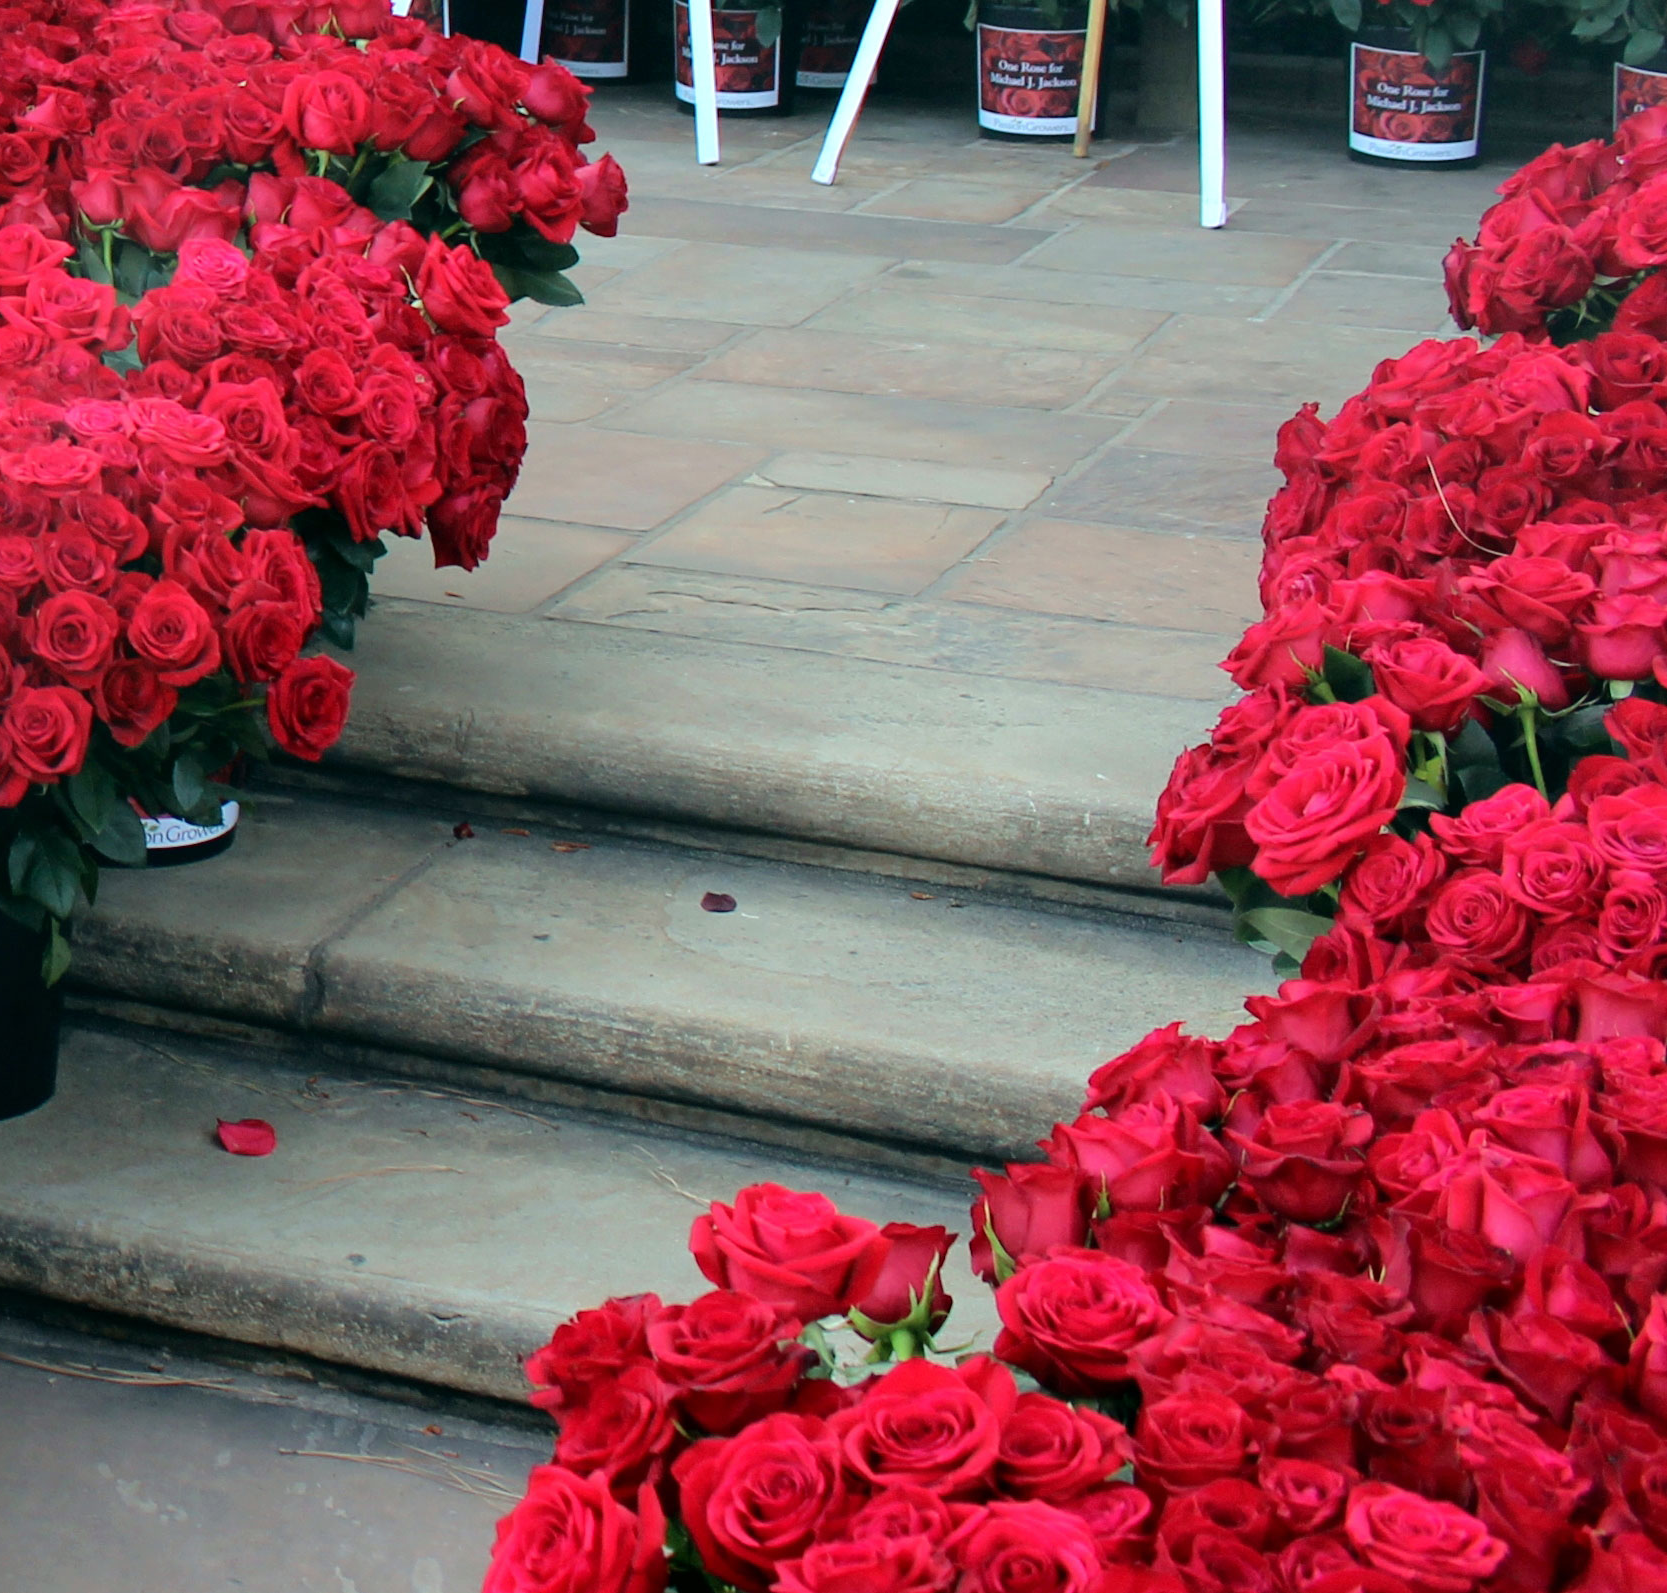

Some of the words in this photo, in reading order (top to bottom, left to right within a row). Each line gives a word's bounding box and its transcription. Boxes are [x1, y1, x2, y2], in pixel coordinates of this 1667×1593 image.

[731, 40, 746, 51] for
[721, 53, 758, 66] Jackson
[998, 59, 1019, 72] One
[1021, 61, 1046, 73] Rose
[1048, 63, 1064, 73] for
[990, 72, 1025, 86] Michael
[1027, 76, 1035, 89] J.
[1037, 76, 1077, 90] Jackson
[1376, 82, 1401, 95] One
[1402, 84, 1431, 97] Rose
[1432, 86, 1449, 97] for
[1366, 94, 1407, 110] Michael
[1420, 100, 1462, 114] Jackson
